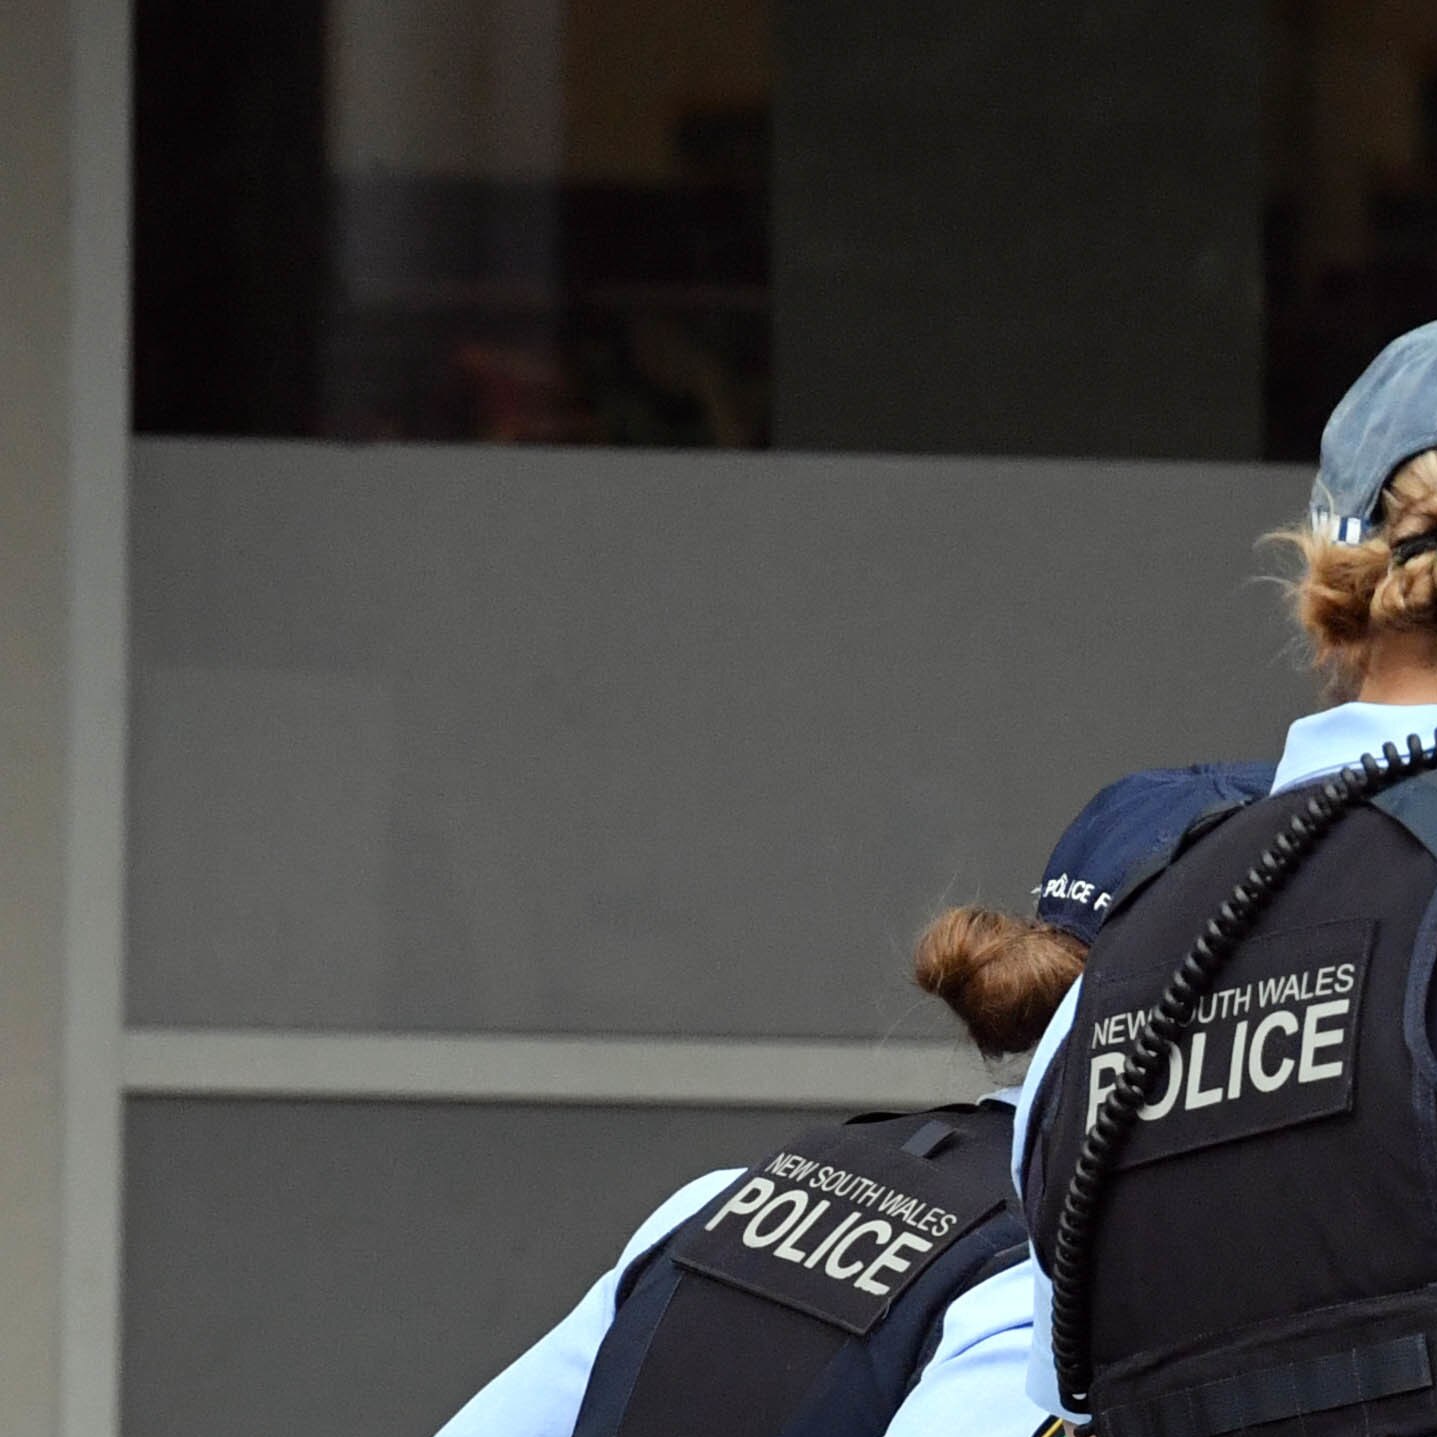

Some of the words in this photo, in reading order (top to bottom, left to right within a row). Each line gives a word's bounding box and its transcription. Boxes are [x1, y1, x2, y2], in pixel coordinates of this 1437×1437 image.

[1043, 876, 1095, 903] POLICE
[1091, 1009, 1152, 1049] NEW
[1178, 984, 1252, 1027] UTH
[1258, 963, 1355, 1008] WALES
[704, 1177, 933, 1295] POLICE
[765, 1152, 819, 1182] NEW
[809, 1166, 886, 1207] SOUTH
[877, 1189, 958, 1237] WALES
